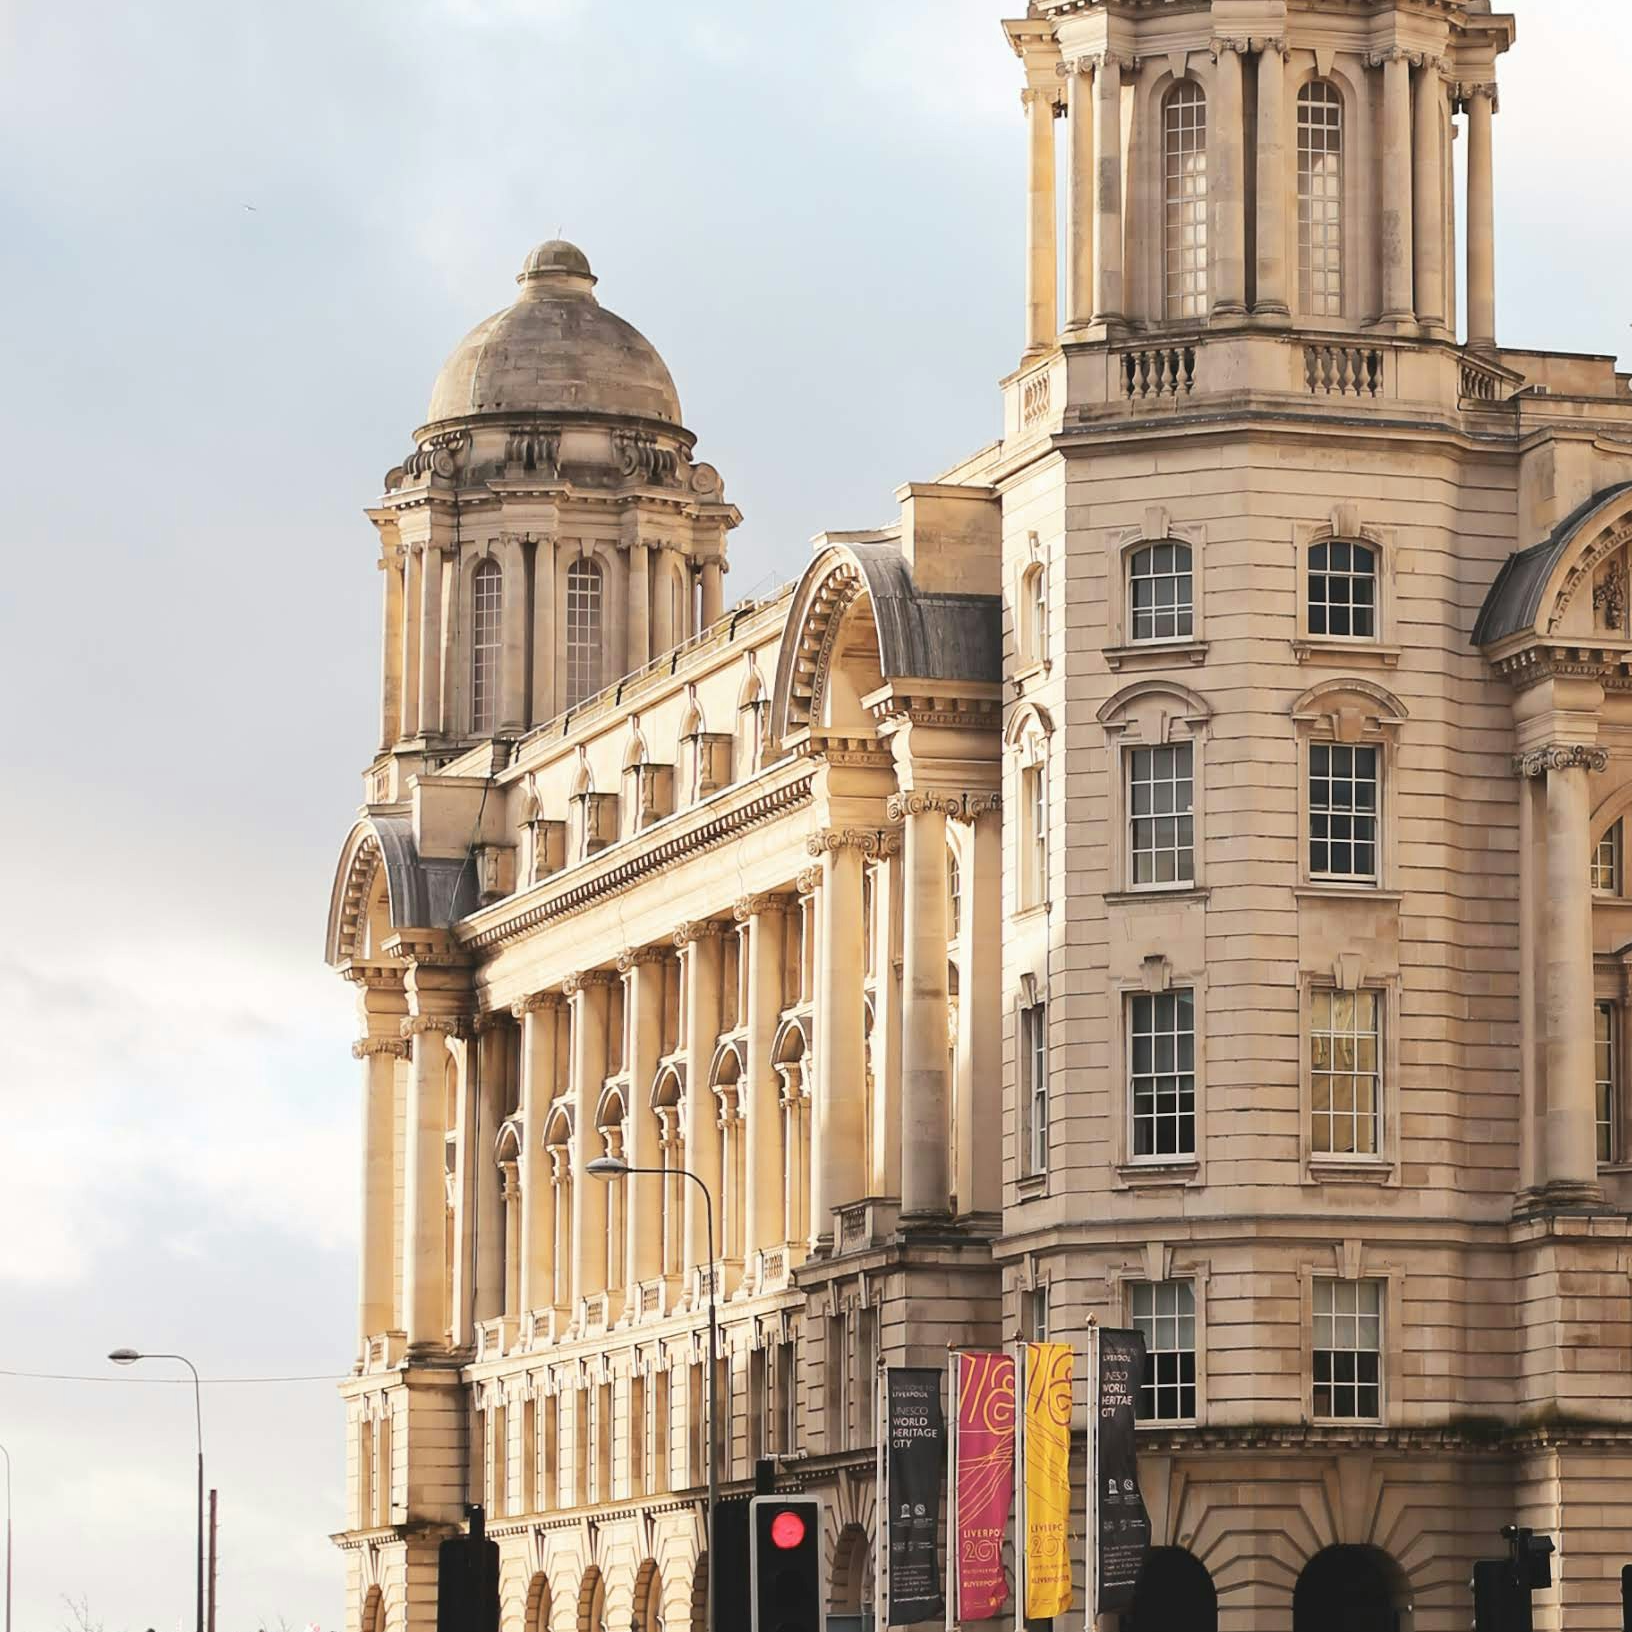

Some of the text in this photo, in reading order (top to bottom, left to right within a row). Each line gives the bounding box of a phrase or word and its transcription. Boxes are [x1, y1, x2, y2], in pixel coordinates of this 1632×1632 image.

[1101, 1395, 1133, 1406] HERITAE
[892, 1417, 928, 1427] WORLD
[892, 1428, 938, 1438] HERITAGE
[892, 1439, 913, 1448] CITY
